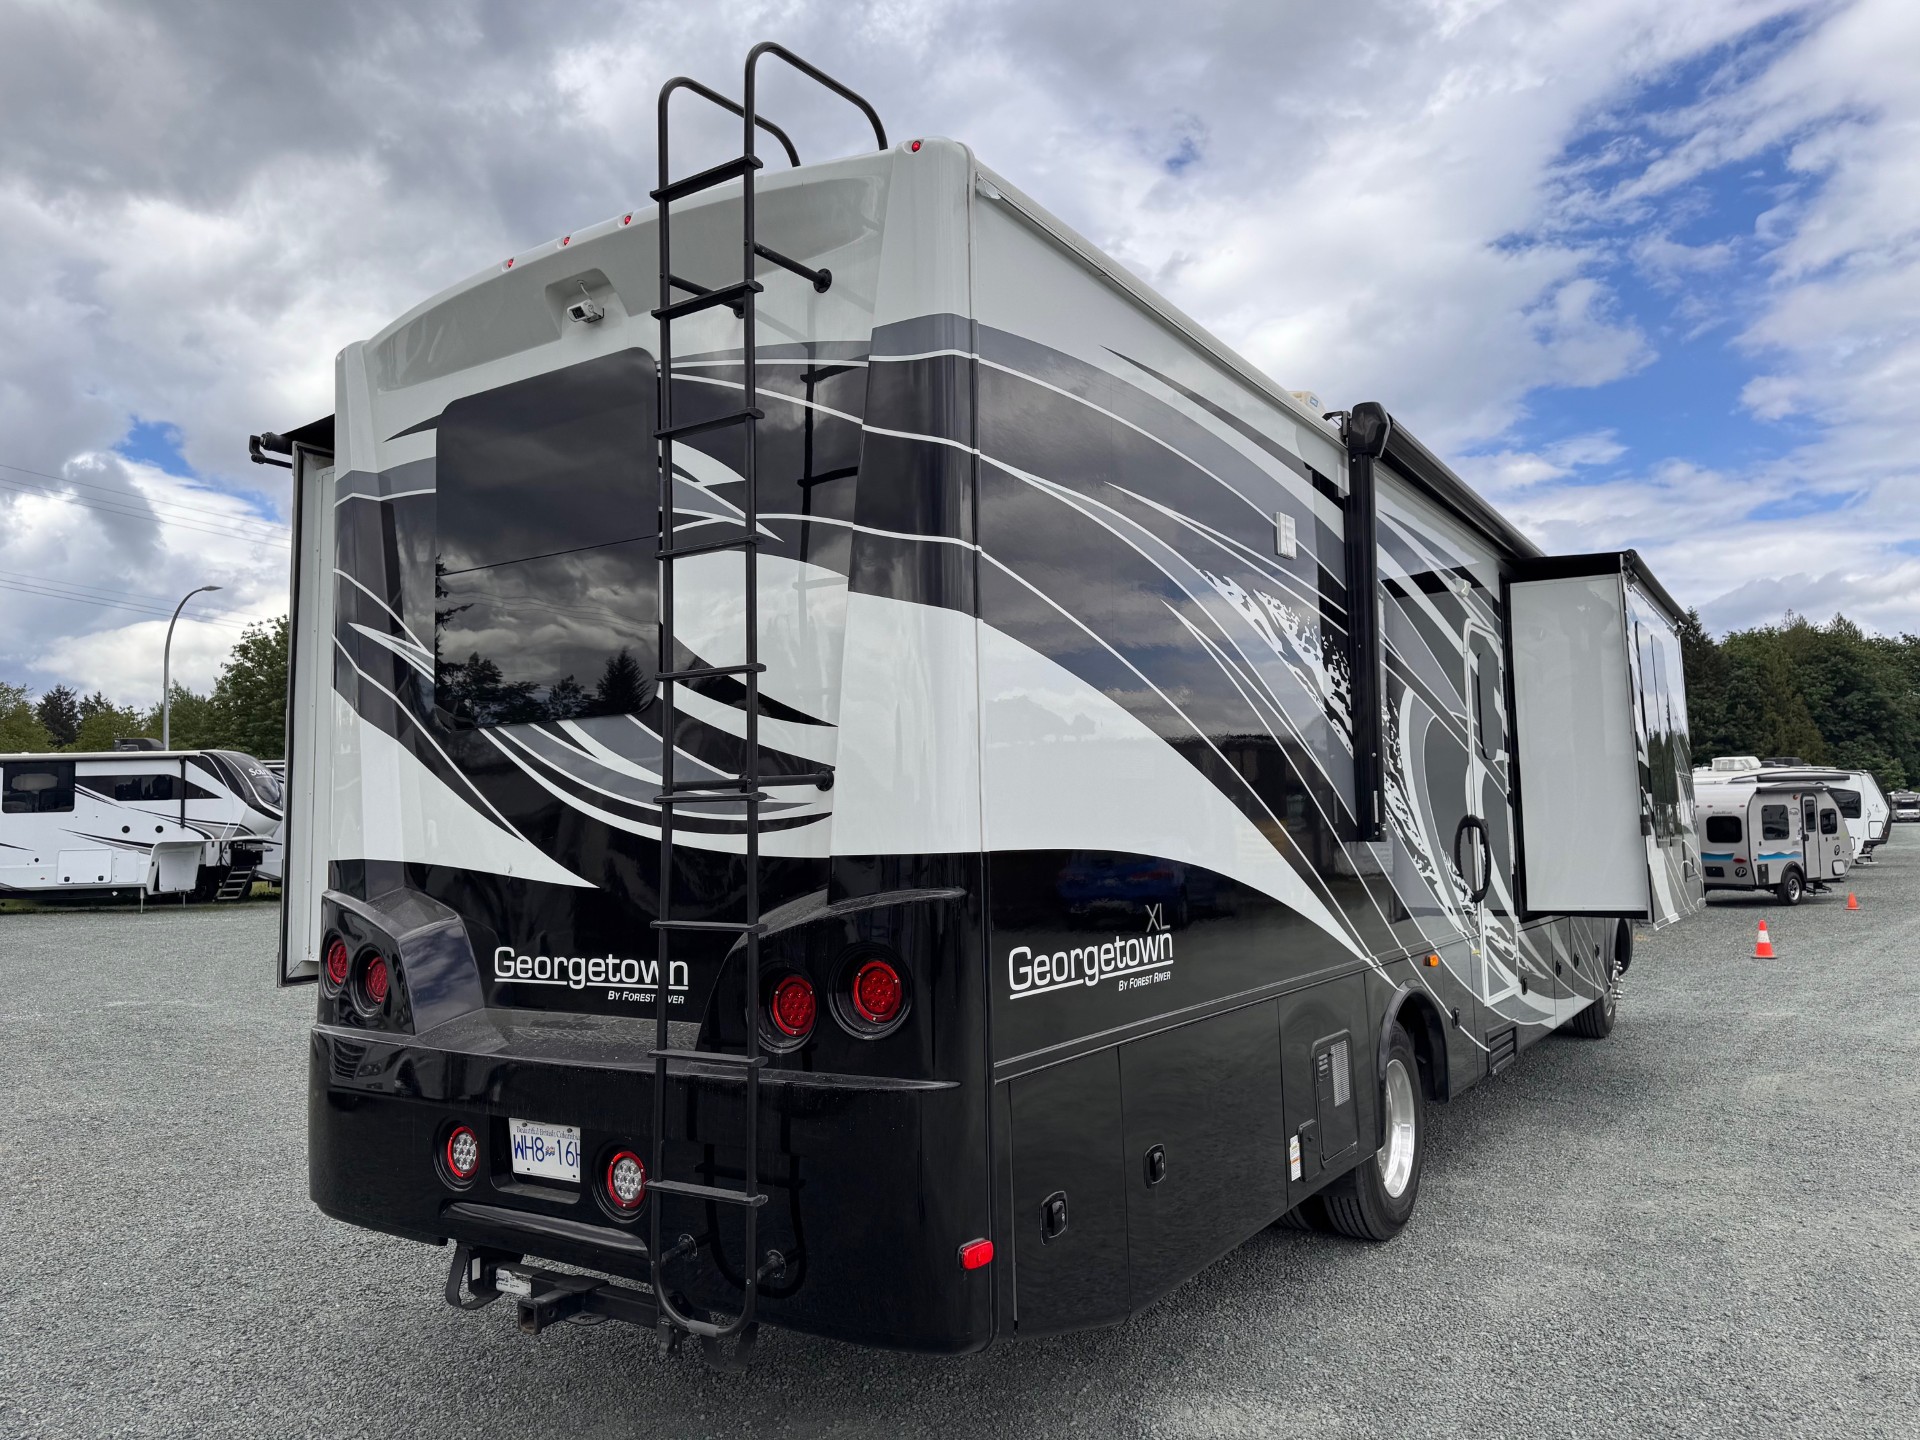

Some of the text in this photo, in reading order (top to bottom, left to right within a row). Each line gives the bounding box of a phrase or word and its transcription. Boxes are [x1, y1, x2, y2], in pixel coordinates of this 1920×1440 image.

[1145, 902, 1171, 932] XL
[1008, 933, 1173, 991] Georgetown
[665, 994, 685, 1004] VER
[513, 1134, 545, 1162] WH8
